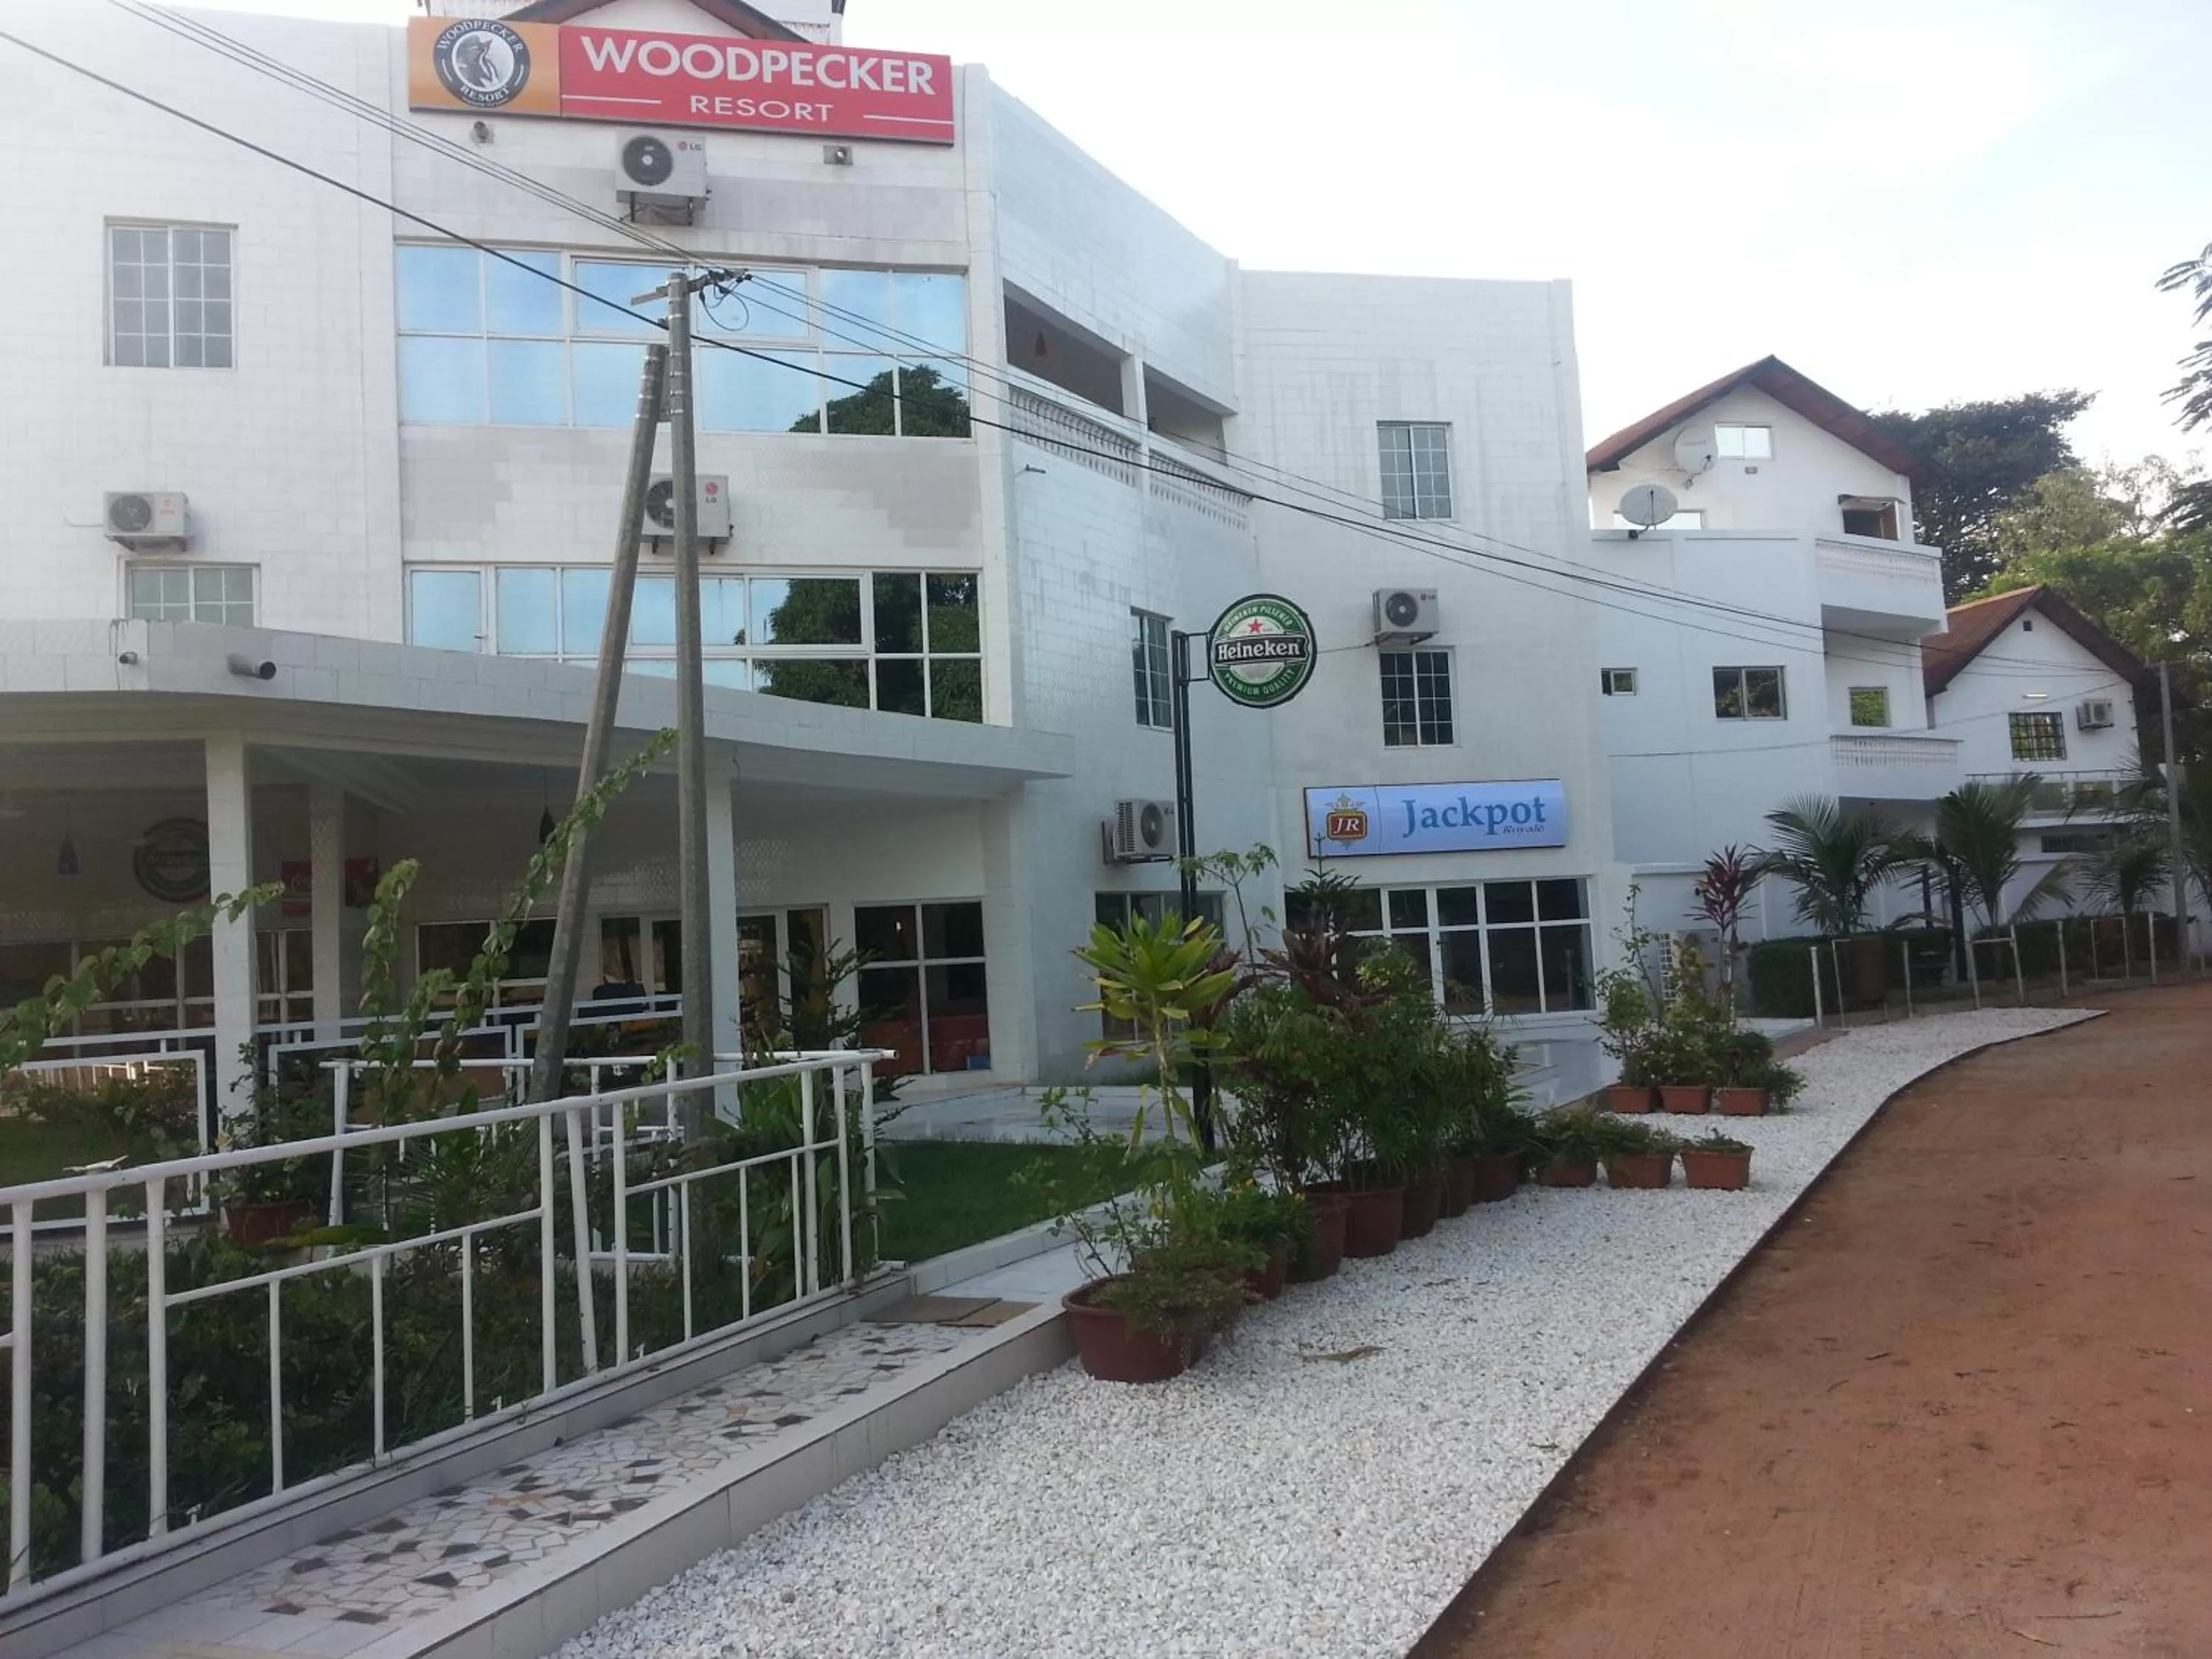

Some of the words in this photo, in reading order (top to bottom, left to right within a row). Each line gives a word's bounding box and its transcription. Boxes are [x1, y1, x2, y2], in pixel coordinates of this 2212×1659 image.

[438, 20, 525, 52] WOODPECKER
[580, 35, 936, 95] WOODPECKER
[460, 85, 510, 102] RESORT
[689, 95, 835, 122] RESORT
[1217, 639, 1301, 661] Heineken
[1223, 672, 1260, 695] PREMIUM
[1262, 668, 1295, 695] QUALITY
[1334, 816, 1360, 834] JR
[1401, 796, 1546, 838] Jackpot
